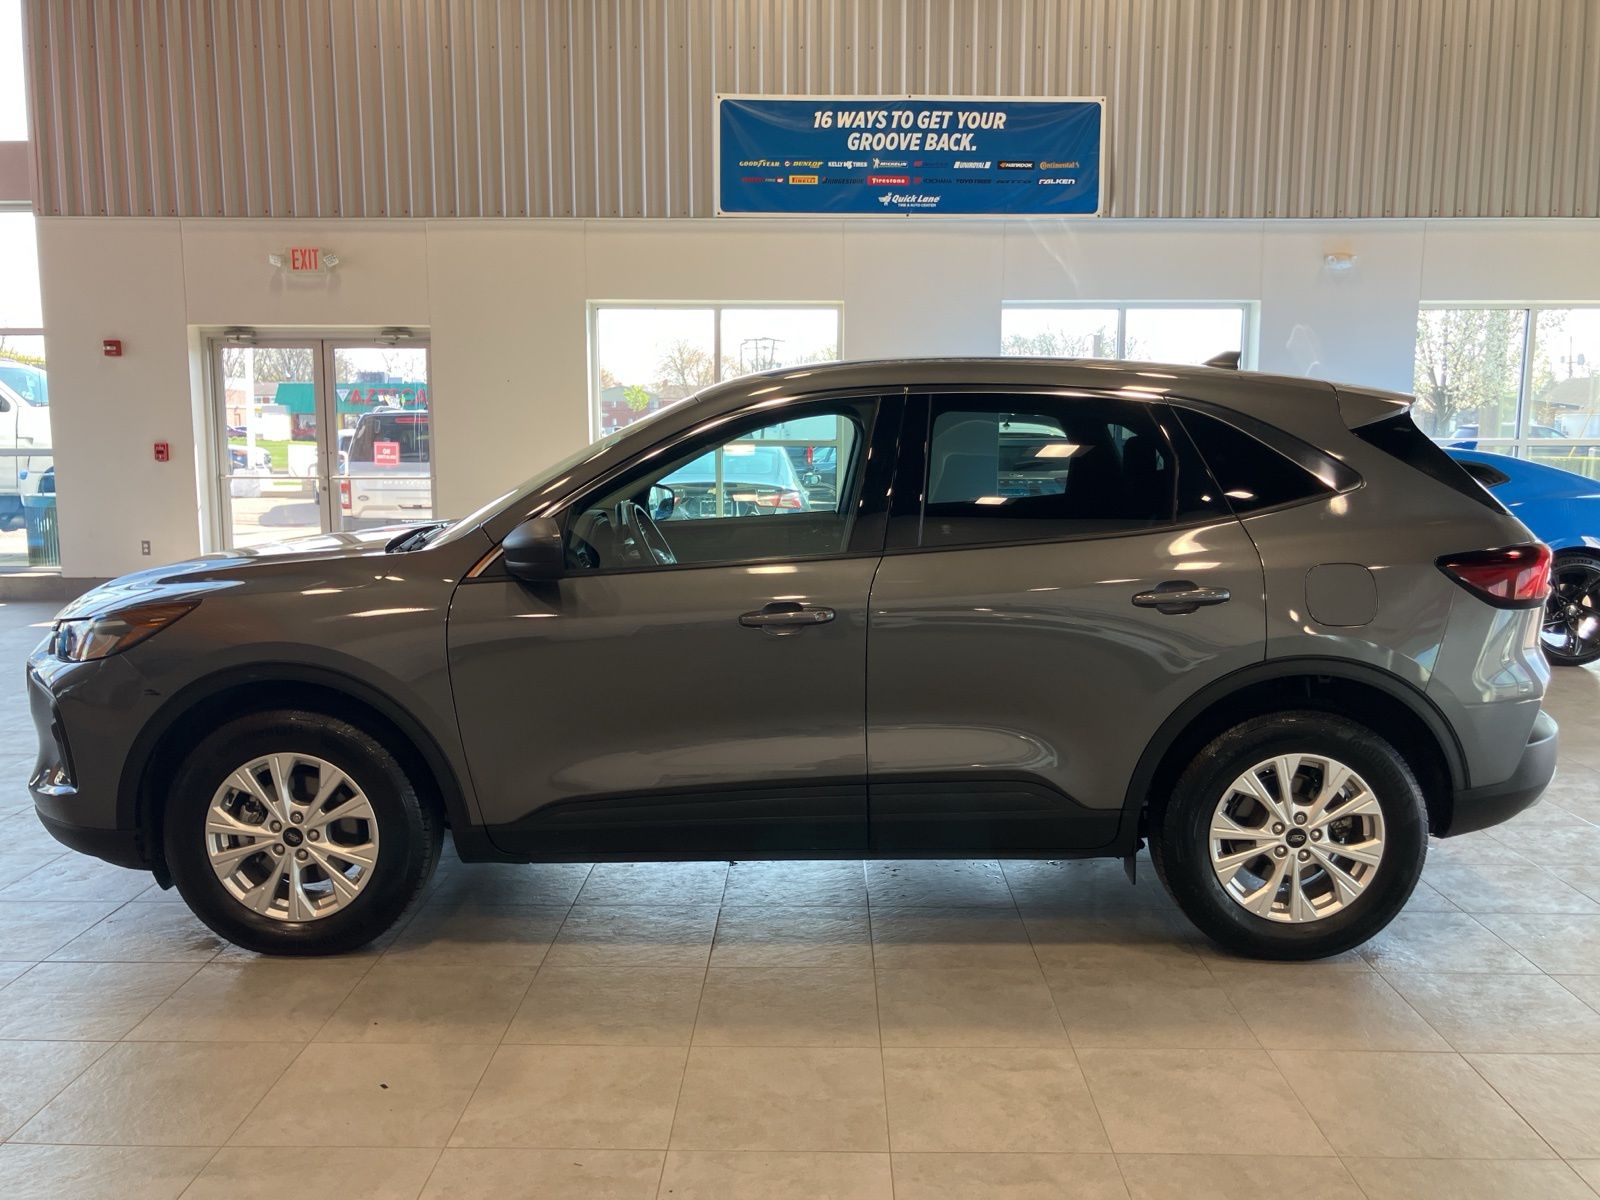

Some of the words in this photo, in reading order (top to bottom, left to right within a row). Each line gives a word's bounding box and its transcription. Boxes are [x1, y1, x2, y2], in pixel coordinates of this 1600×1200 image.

[814, 111, 833, 129] 16
[837, 111, 887, 129] WAYS
[891, 111, 914, 129] TO
[917, 111, 953, 129] GET
[957, 111, 1007, 130] YOUR
[847, 132, 922, 151] GROOVE
[924, 133, 977, 151] BACK.
[739, 160, 780, 168] GOODYEAR
[891, 194, 917, 204] Quick
[917, 194, 940, 203] Lane
[291, 248, 319, 271] EXIT
